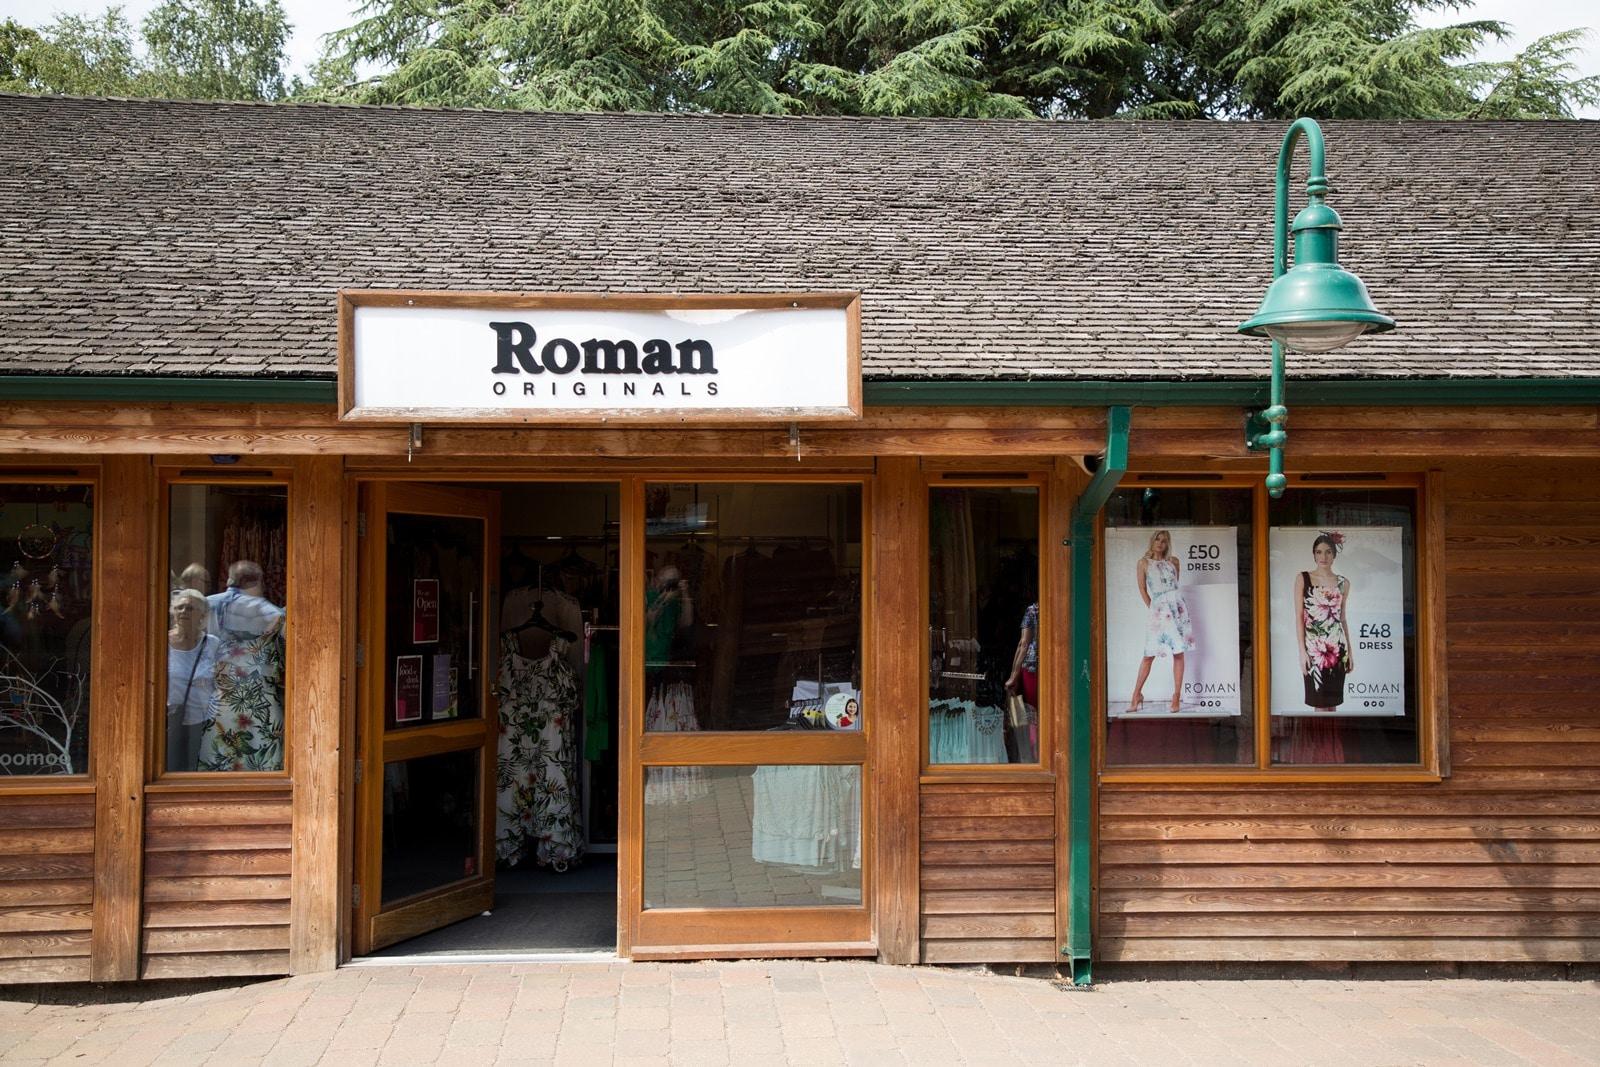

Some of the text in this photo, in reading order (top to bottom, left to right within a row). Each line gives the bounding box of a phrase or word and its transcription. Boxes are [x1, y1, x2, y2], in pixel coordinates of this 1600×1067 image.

[489, 321, 718, 375] Roman
[492, 381, 719, 396] ORIGINALS
[1188, 544, 1220, 560] £50
[1187, 562, 1221, 571] DRESS
[1359, 623, 1392, 639] £48
[1359, 641, 1393, 650] DRESS
[1184, 682, 1236, 694] ROMAN
[1348, 682, 1400, 694] ROMAN
